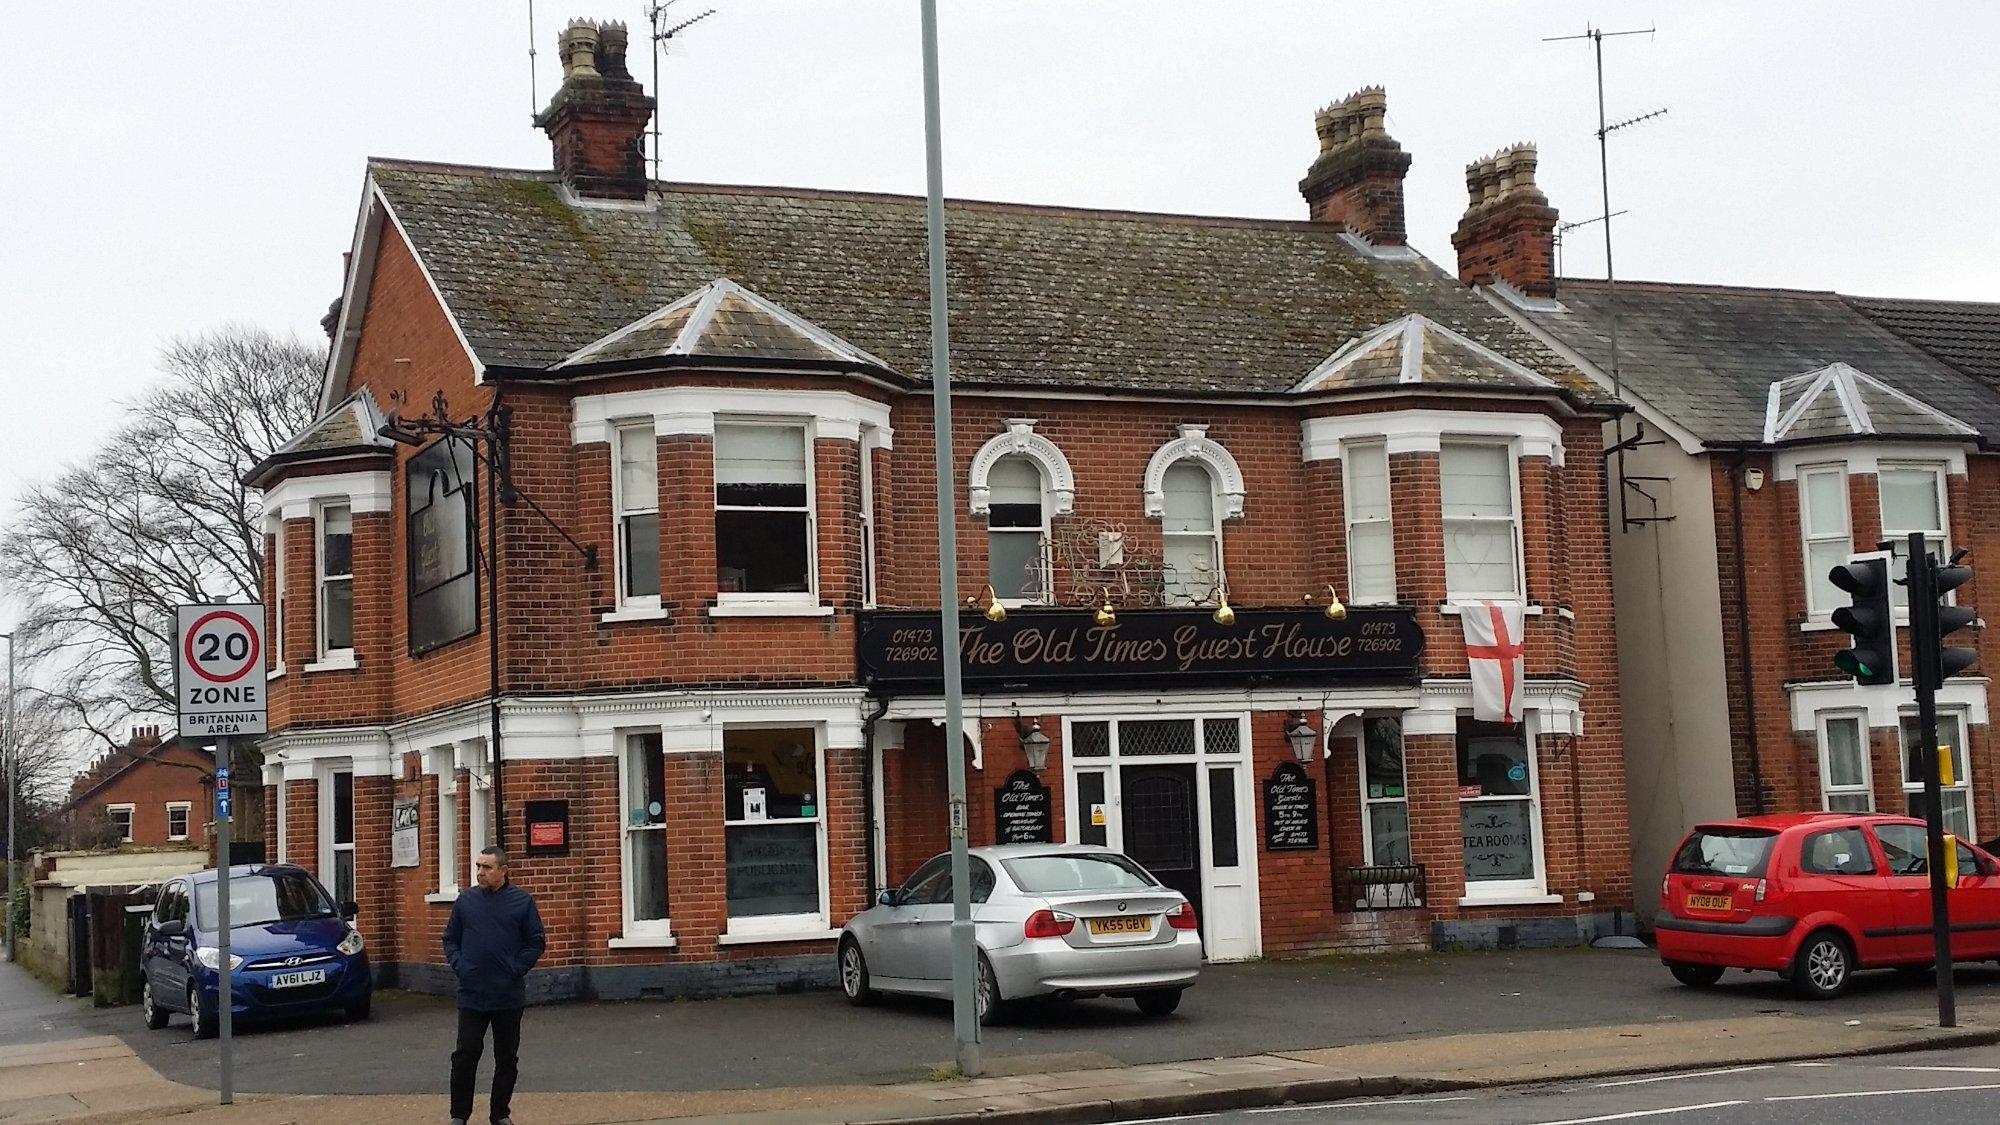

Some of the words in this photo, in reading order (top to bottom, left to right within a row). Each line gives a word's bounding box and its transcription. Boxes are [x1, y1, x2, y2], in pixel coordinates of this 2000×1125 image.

[1361, 622, 1397, 635] 01473
[892, 629, 932, 644] 01473
[198, 632, 249, 661] 20
[959, 625, 1005, 665] The
[1012, 627, 1079, 665] Old
[1084, 624, 1168, 663] Times
[1173, 624, 1257, 671] Guest
[1261, 622, 1352, 659] House
[1357, 638, 1401, 652] 726902
[885, 646, 938, 662] 726902
[190, 686, 256, 704] ZONE
[189, 714, 258, 725] BRITANNIA
[207, 724, 240, 734] AREA
[1280, 773, 1296, 782] The
[1013, 781, 1030, 790] The
[1270, 784, 1286, 794] Old
[1002, 792, 1020, 802] Old
[1020, 792, 1044, 802] Times
[1462, 836, 1484, 848] TEA
[1486, 834, 1528, 847] ROOMS
[1690, 896, 1711, 907] NY08
[1712, 896, 1729, 908] OUF
[1095, 919, 1124, 931] YK55
[1125, 918, 1146, 930] GBV
[300, 971, 322, 983] LJZ
